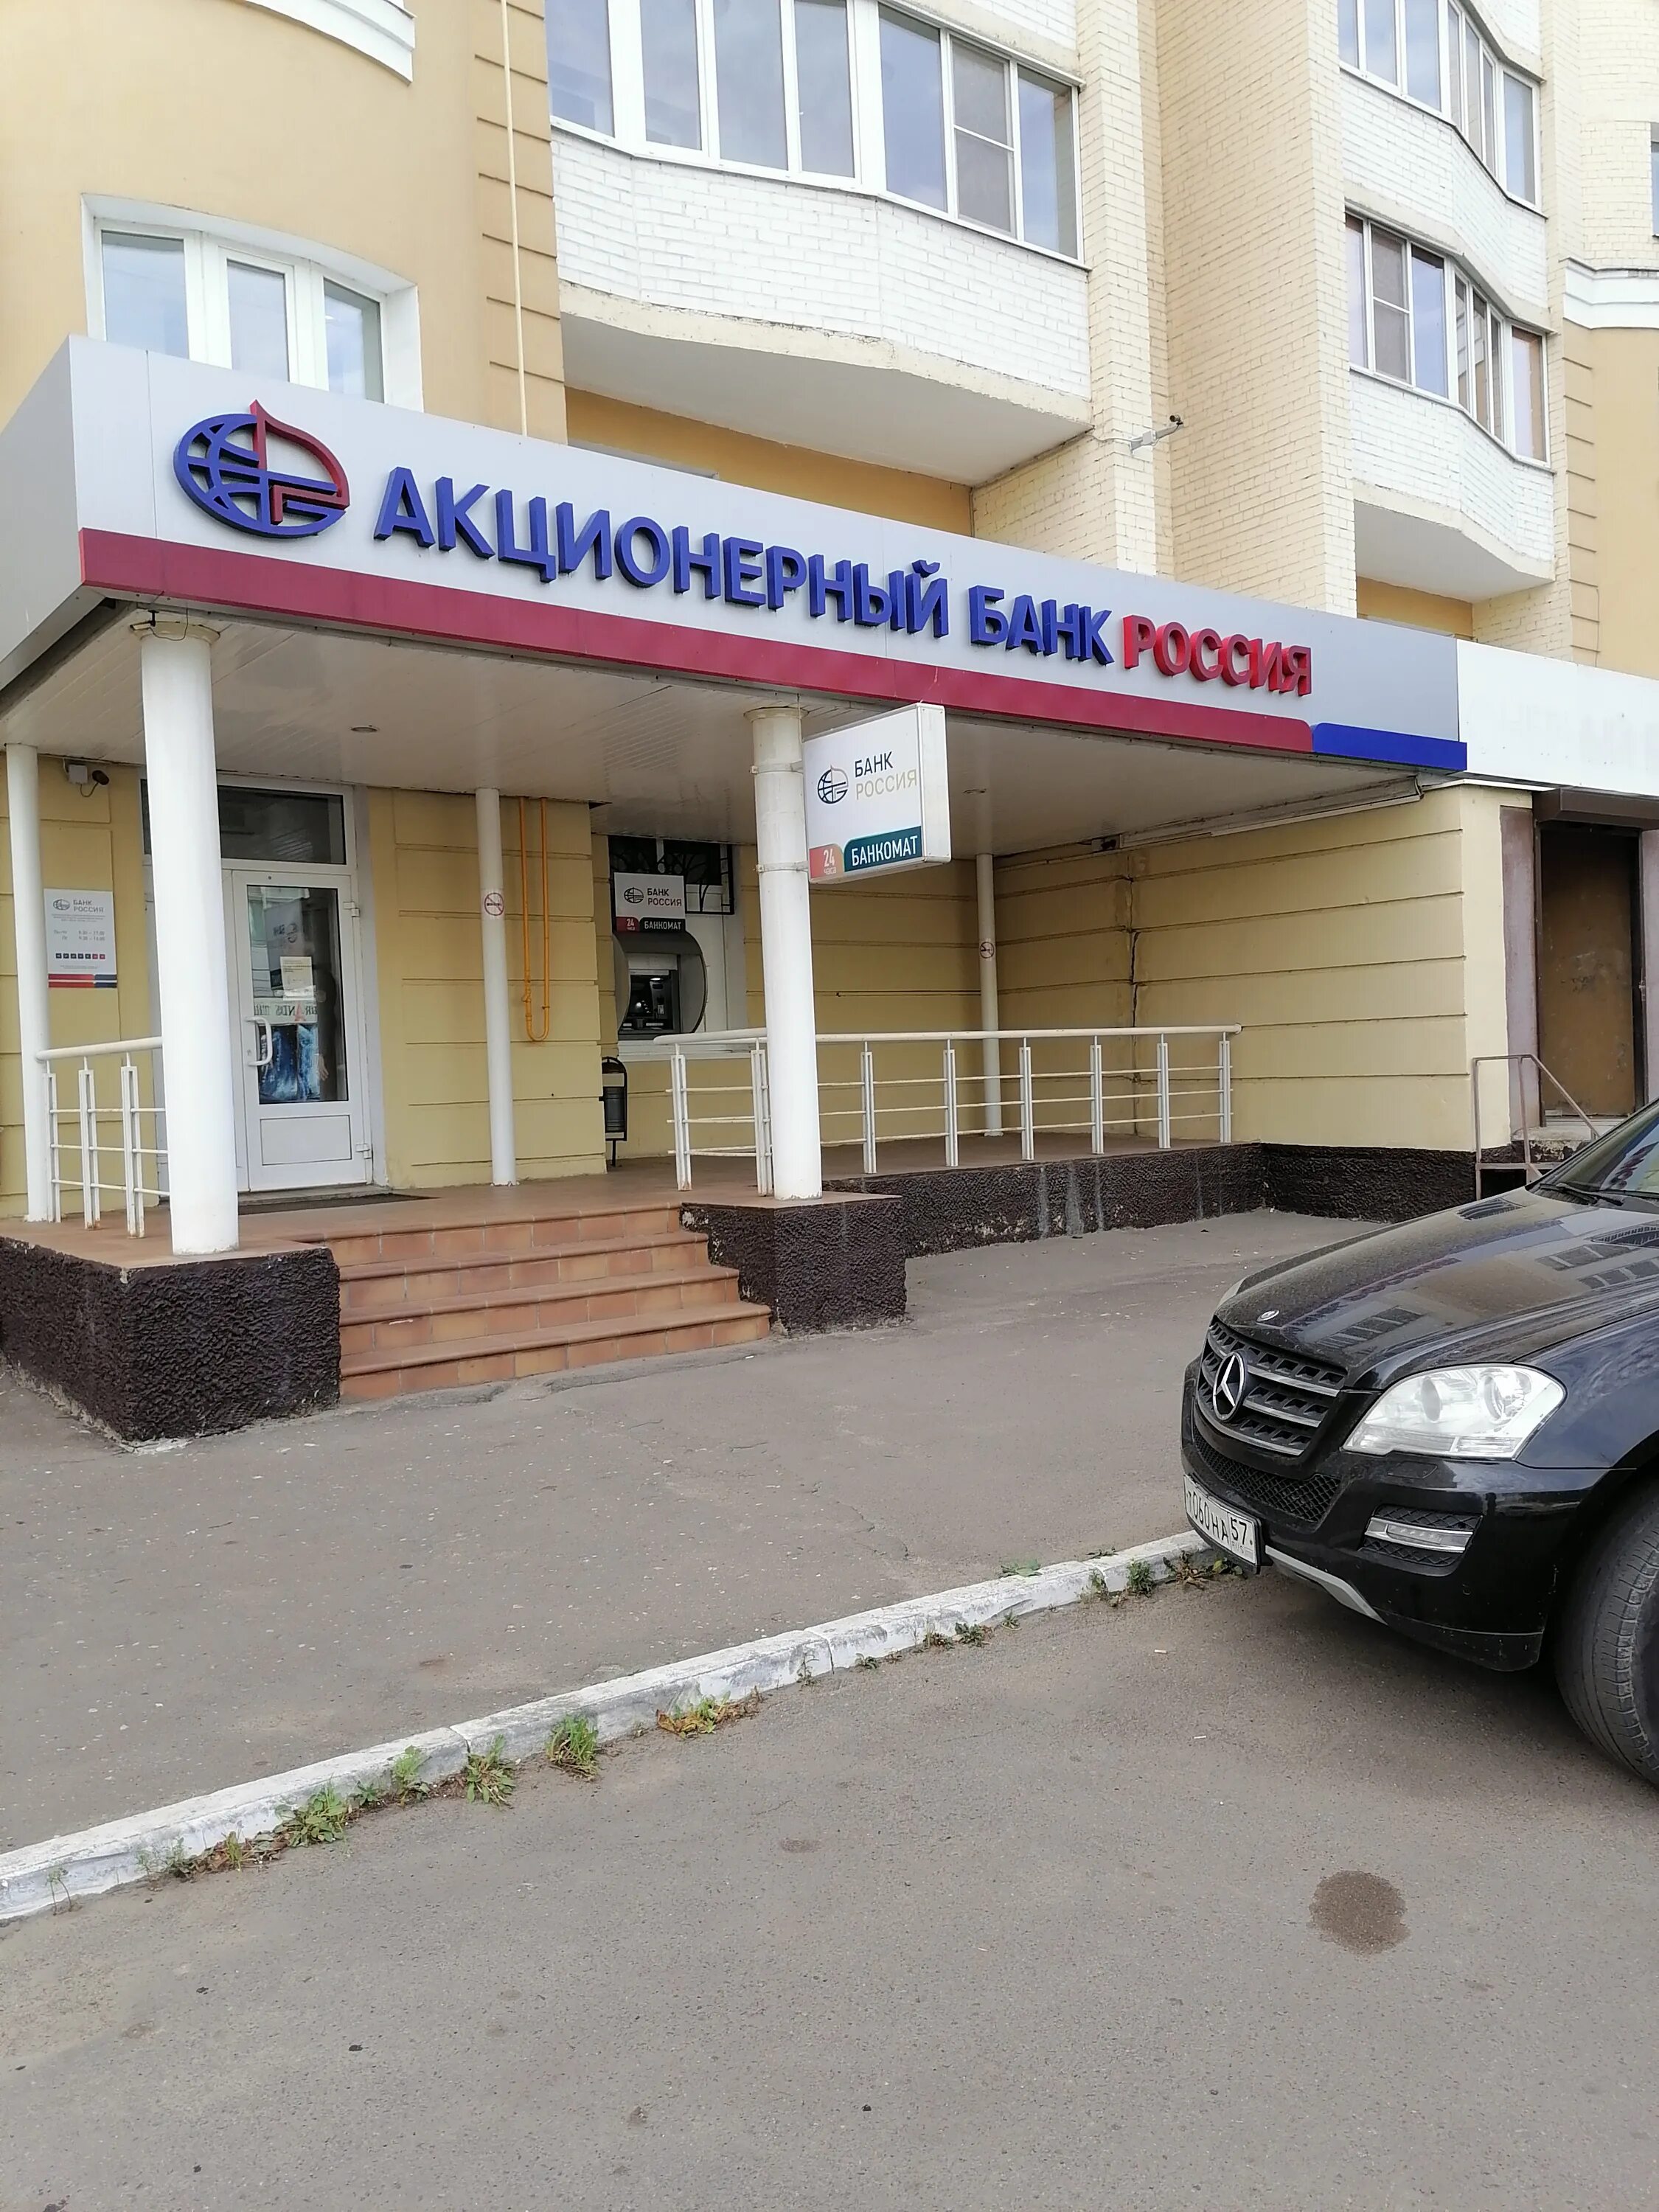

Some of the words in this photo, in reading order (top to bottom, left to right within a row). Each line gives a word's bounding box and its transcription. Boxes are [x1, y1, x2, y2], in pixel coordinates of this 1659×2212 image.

[373, 466, 949, 639] АКЦИОНЕРНЫЙ
[969, 585, 1114, 665] БАНК
[1122, 614, 1313, 696] РОССИЯ
[855, 751, 894, 778] БАНК
[856, 769, 917, 801] РОССИЯ
[823, 849, 835, 868] 24
[851, 835, 918, 867] БАНКОМАТ
[647, 888, 669, 897] БАНК
[647, 897, 682, 907] РОССИЯ
[627, 918, 635, 927] 24
[644, 920, 681, 931] БАНКОМАТ
[1231, 1517, 1248, 1545] 57
